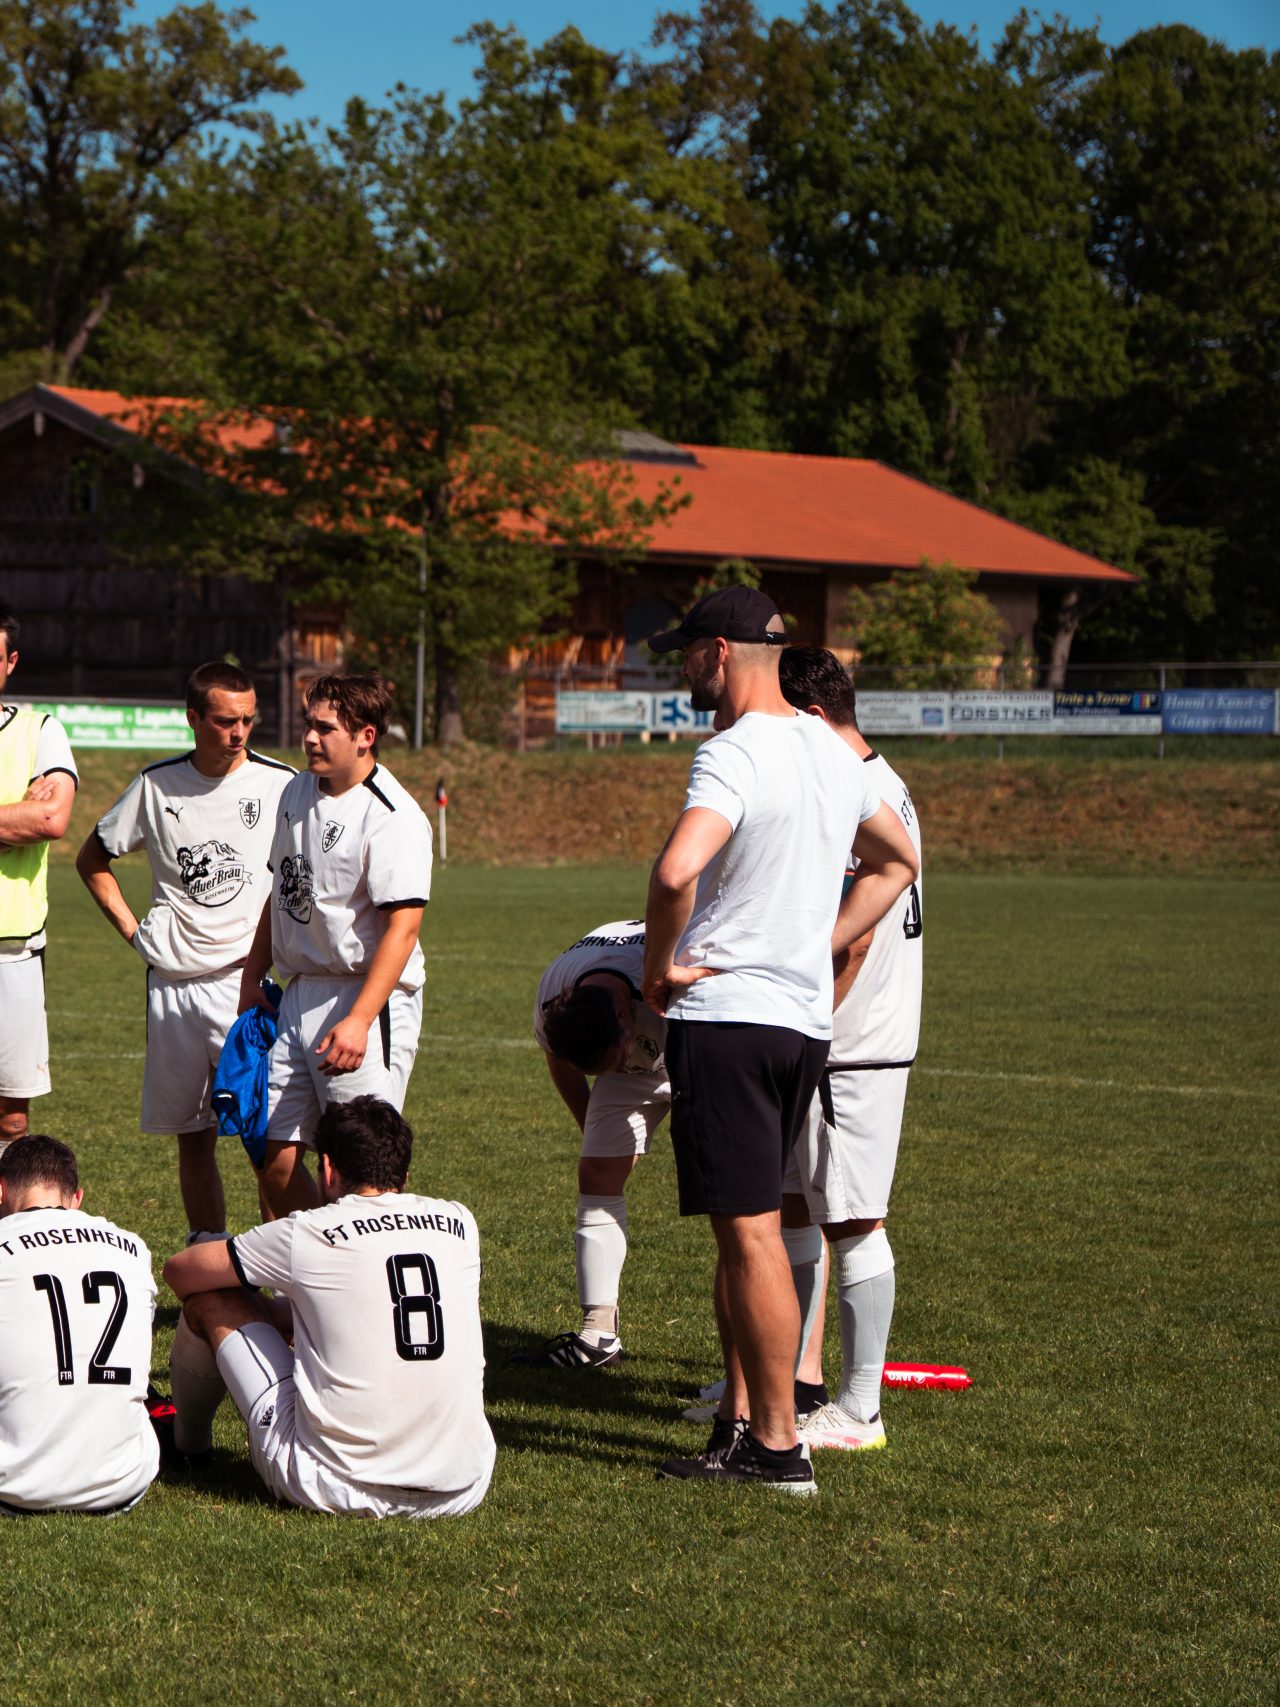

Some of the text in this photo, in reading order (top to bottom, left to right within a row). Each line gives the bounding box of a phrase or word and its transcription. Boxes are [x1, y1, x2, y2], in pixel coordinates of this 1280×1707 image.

[1056, 692, 1085, 705] Tinte
[1096, 691, 1132, 705] Toner
[951, 704, 1051, 721] FORSTNER
[901, 800, 913, 826] FT
[205, 886, 235, 901] ROSENHEIM
[322, 1213, 466, 1246] FT ROSENHEIM
[18, 1228, 138, 1258] ROSENHEIM
[385, 1253, 445, 1361] 8
[32, 1270, 132, 1386] 12
[413, 1346, 427, 1356] FTR
[60, 1370, 73, 1381] FTR
[103, 1370, 116, 1380] FTR
